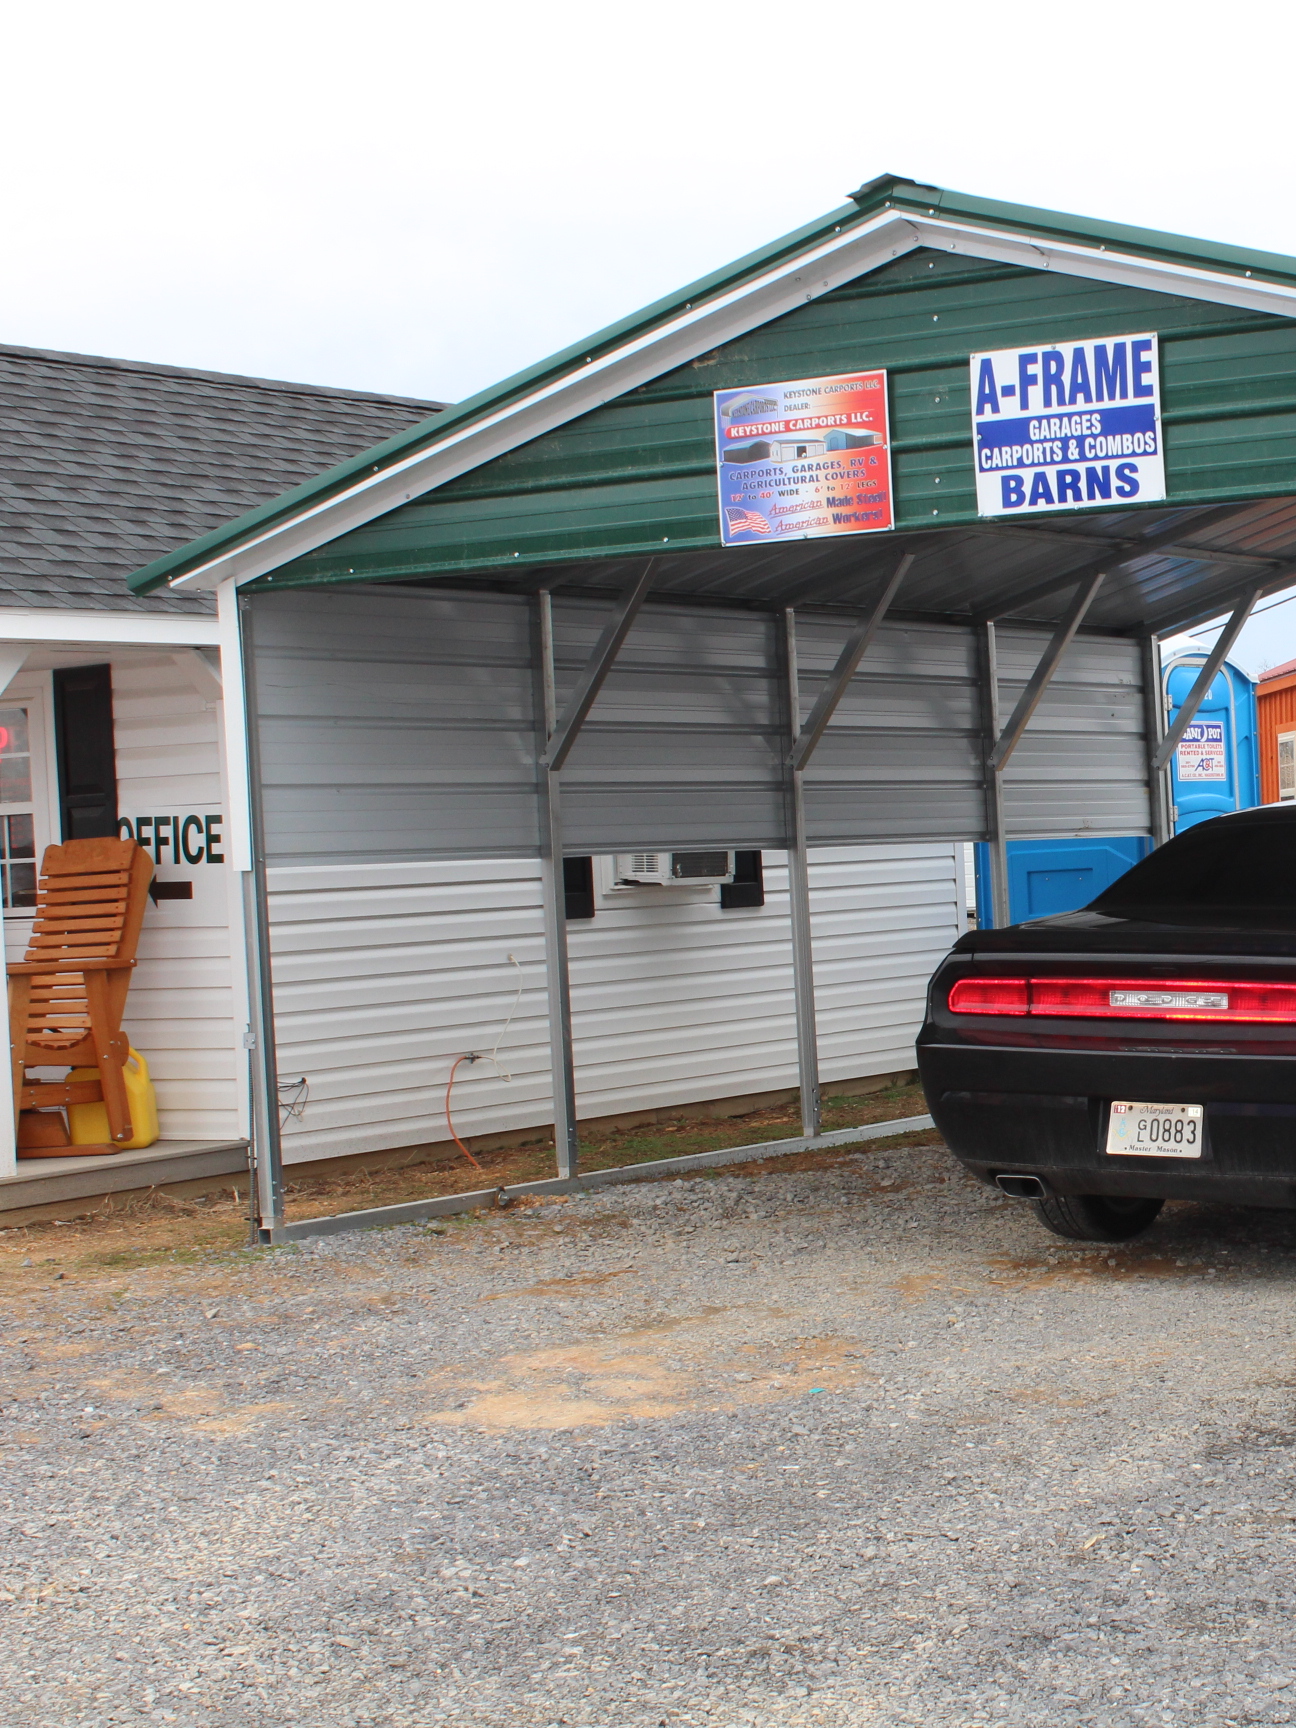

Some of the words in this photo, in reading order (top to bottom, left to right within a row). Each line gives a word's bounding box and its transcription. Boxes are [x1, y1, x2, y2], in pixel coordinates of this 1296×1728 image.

[975, 338, 1154, 416] A-FRAME
[783, 388, 822, 400] KEYSTONE
[824, 382, 863, 395] CARPORTS
[865, 380, 881, 390] LLC.
[784, 402, 811, 412] DEALER:
[730, 422, 786, 438] KEYSTONE
[789, 413, 848, 430] CARPORTS
[851, 411, 873, 423] LLC.
[1029, 412, 1101, 441] GARAGES
[980, 441, 1063, 469] CARPORTS
[1067, 439, 1080, 460] &
[1084, 431, 1156, 459] COMBOS
[729, 466, 788, 482] CARPORTS,
[792, 460, 846, 475] GARAGES,
[850, 458, 865, 467] RV
[869, 456, 878, 465] &
[742, 474, 821, 491] AGRICULTURAL
[824, 468, 866, 482] COVERS
[778, 488, 800, 498] WIDE
[826, 484, 836, 492] to
[857, 480, 878, 488] LEGS
[1000, 462, 1140, 509] BARNS
[767, 500, 824, 516] American
[826, 494, 854, 509] Made
[774, 516, 830, 534] American
[832, 508, 884, 525] Workers!
[1208, 728, 1221, 740] POT
[1114, 994, 1222, 1006] DODGE
[1117, 1105, 1126, 1113] 12
[1140, 1106, 1175, 1117] Maryland
